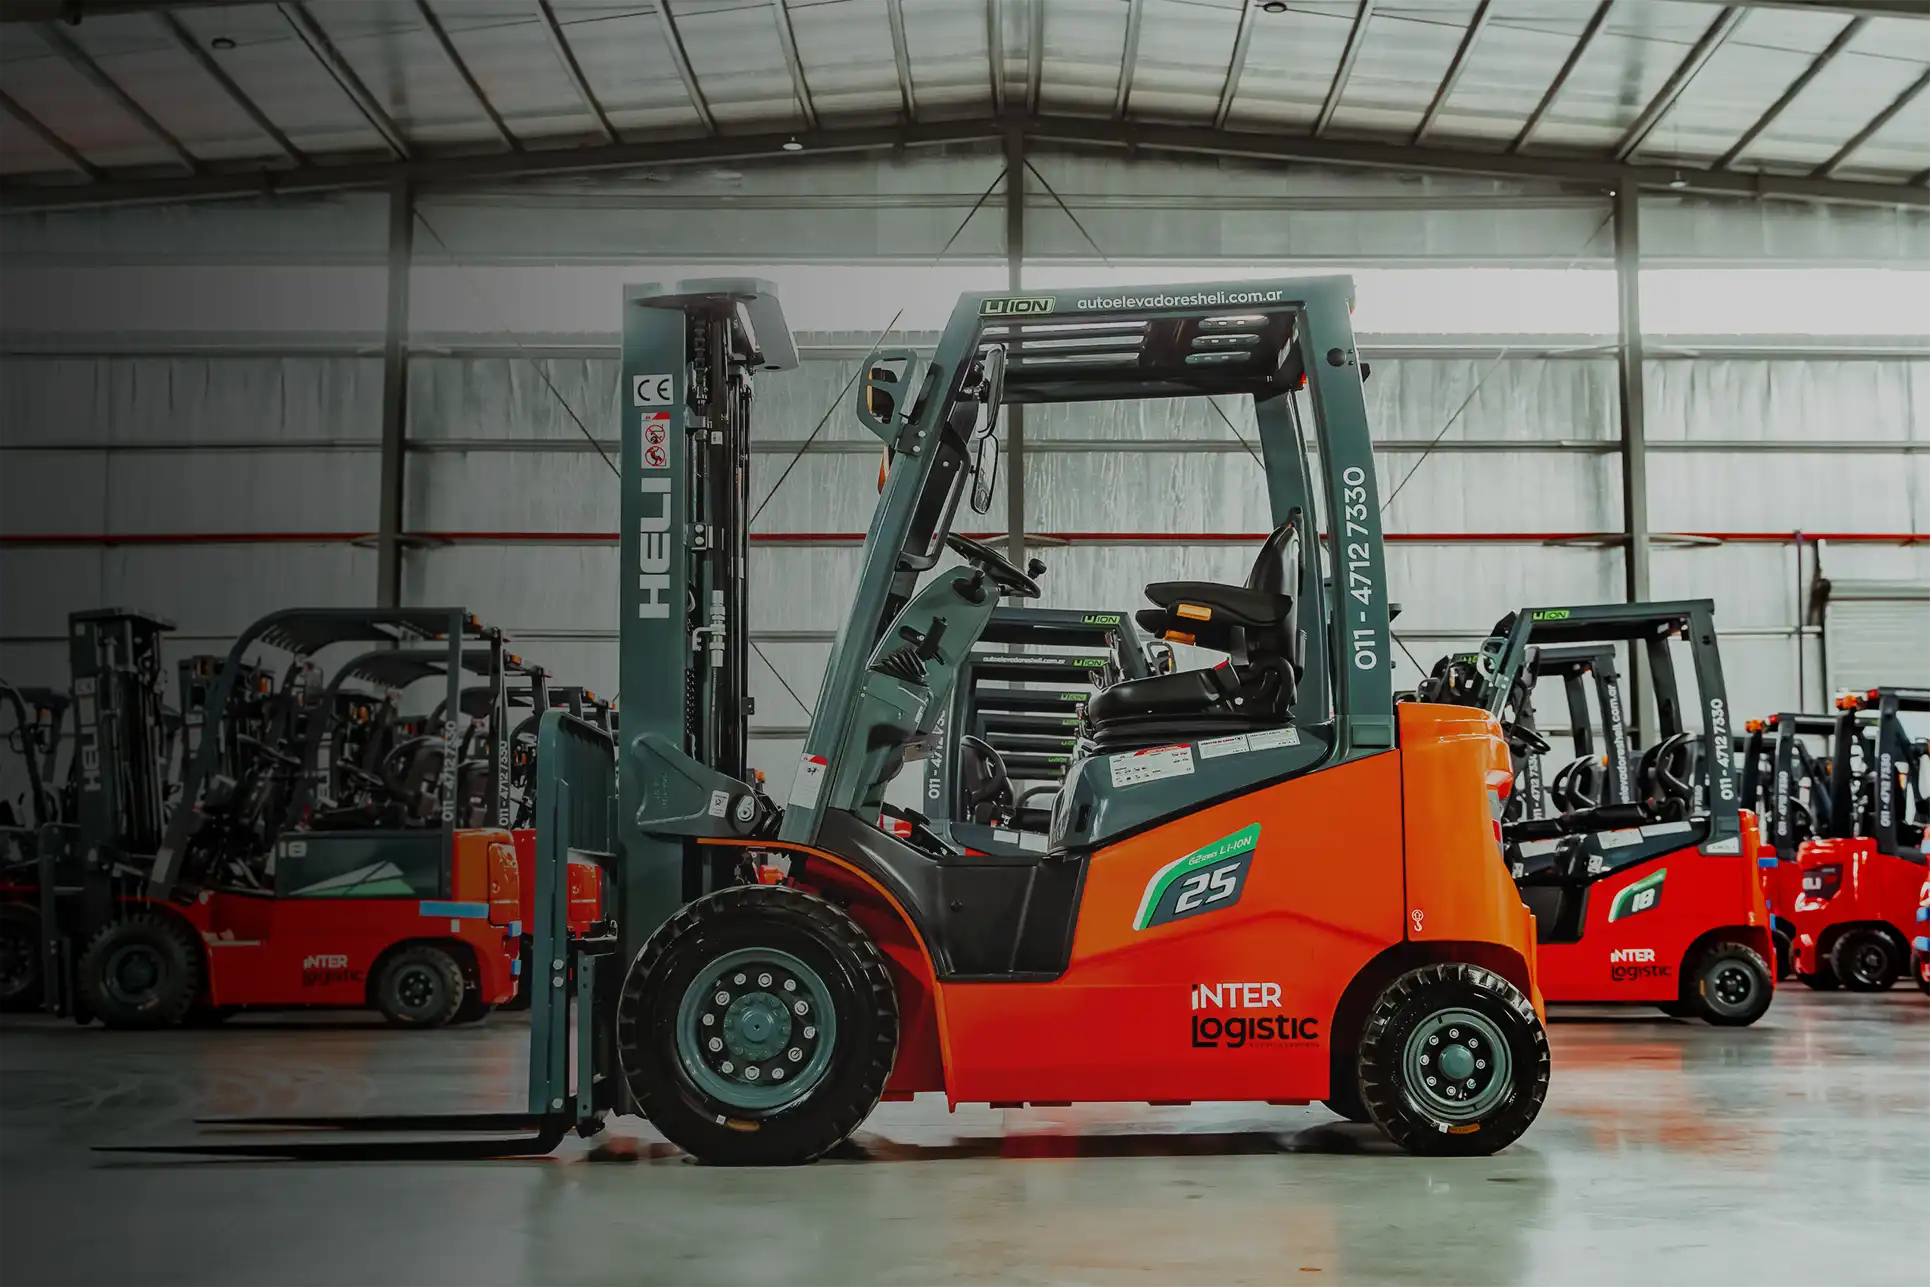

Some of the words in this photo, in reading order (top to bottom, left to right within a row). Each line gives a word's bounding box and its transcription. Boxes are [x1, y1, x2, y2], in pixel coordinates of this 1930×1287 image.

[1077, 288, 1283, 310] autoelevadoresheli.com.ar
[1342, 466, 1368, 536] 7330
[639, 478, 672, 618] HELI
[1348, 542, 1372, 606] 4712
[1353, 629, 1377, 670] 011
[80, 726, 102, 792] HELI
[1715, 735, 1730, 768] 4712
[1174, 862, 1242, 914] 25
